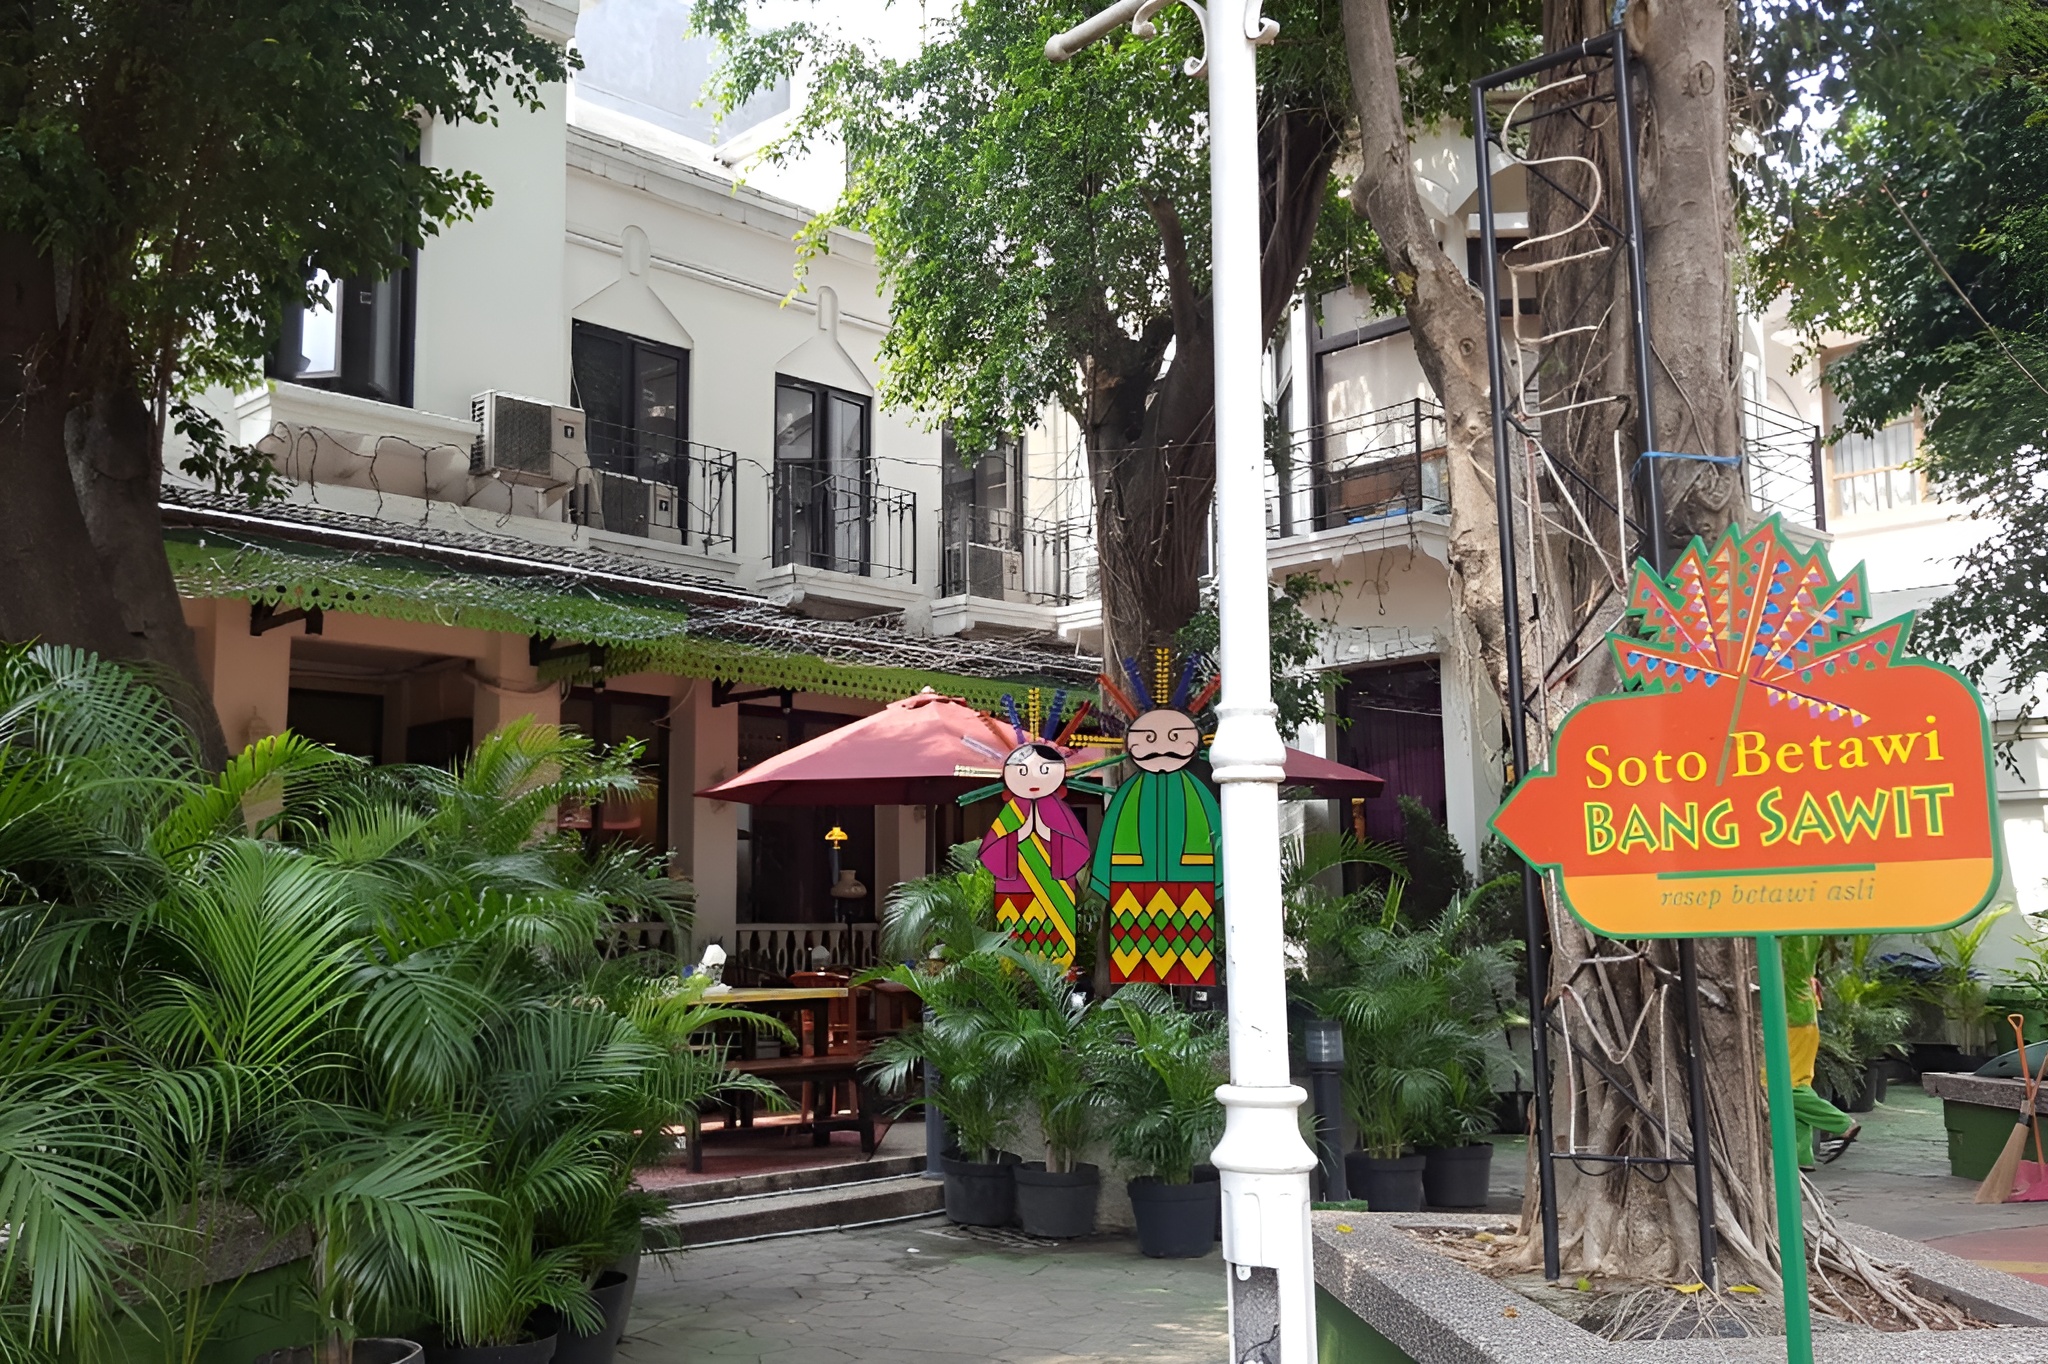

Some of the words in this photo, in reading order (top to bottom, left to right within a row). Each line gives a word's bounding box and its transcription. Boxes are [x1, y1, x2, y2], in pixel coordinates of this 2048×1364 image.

[1585, 744, 1708, 789] Soto
[1727, 714, 1945, 778] Betawi
[1583, 800, 1740, 856] BANG
[1755, 783, 1955, 847] SAWIT
[1731, 880, 1817, 905] betawi
[1826, 878, 1875, 901] asli
